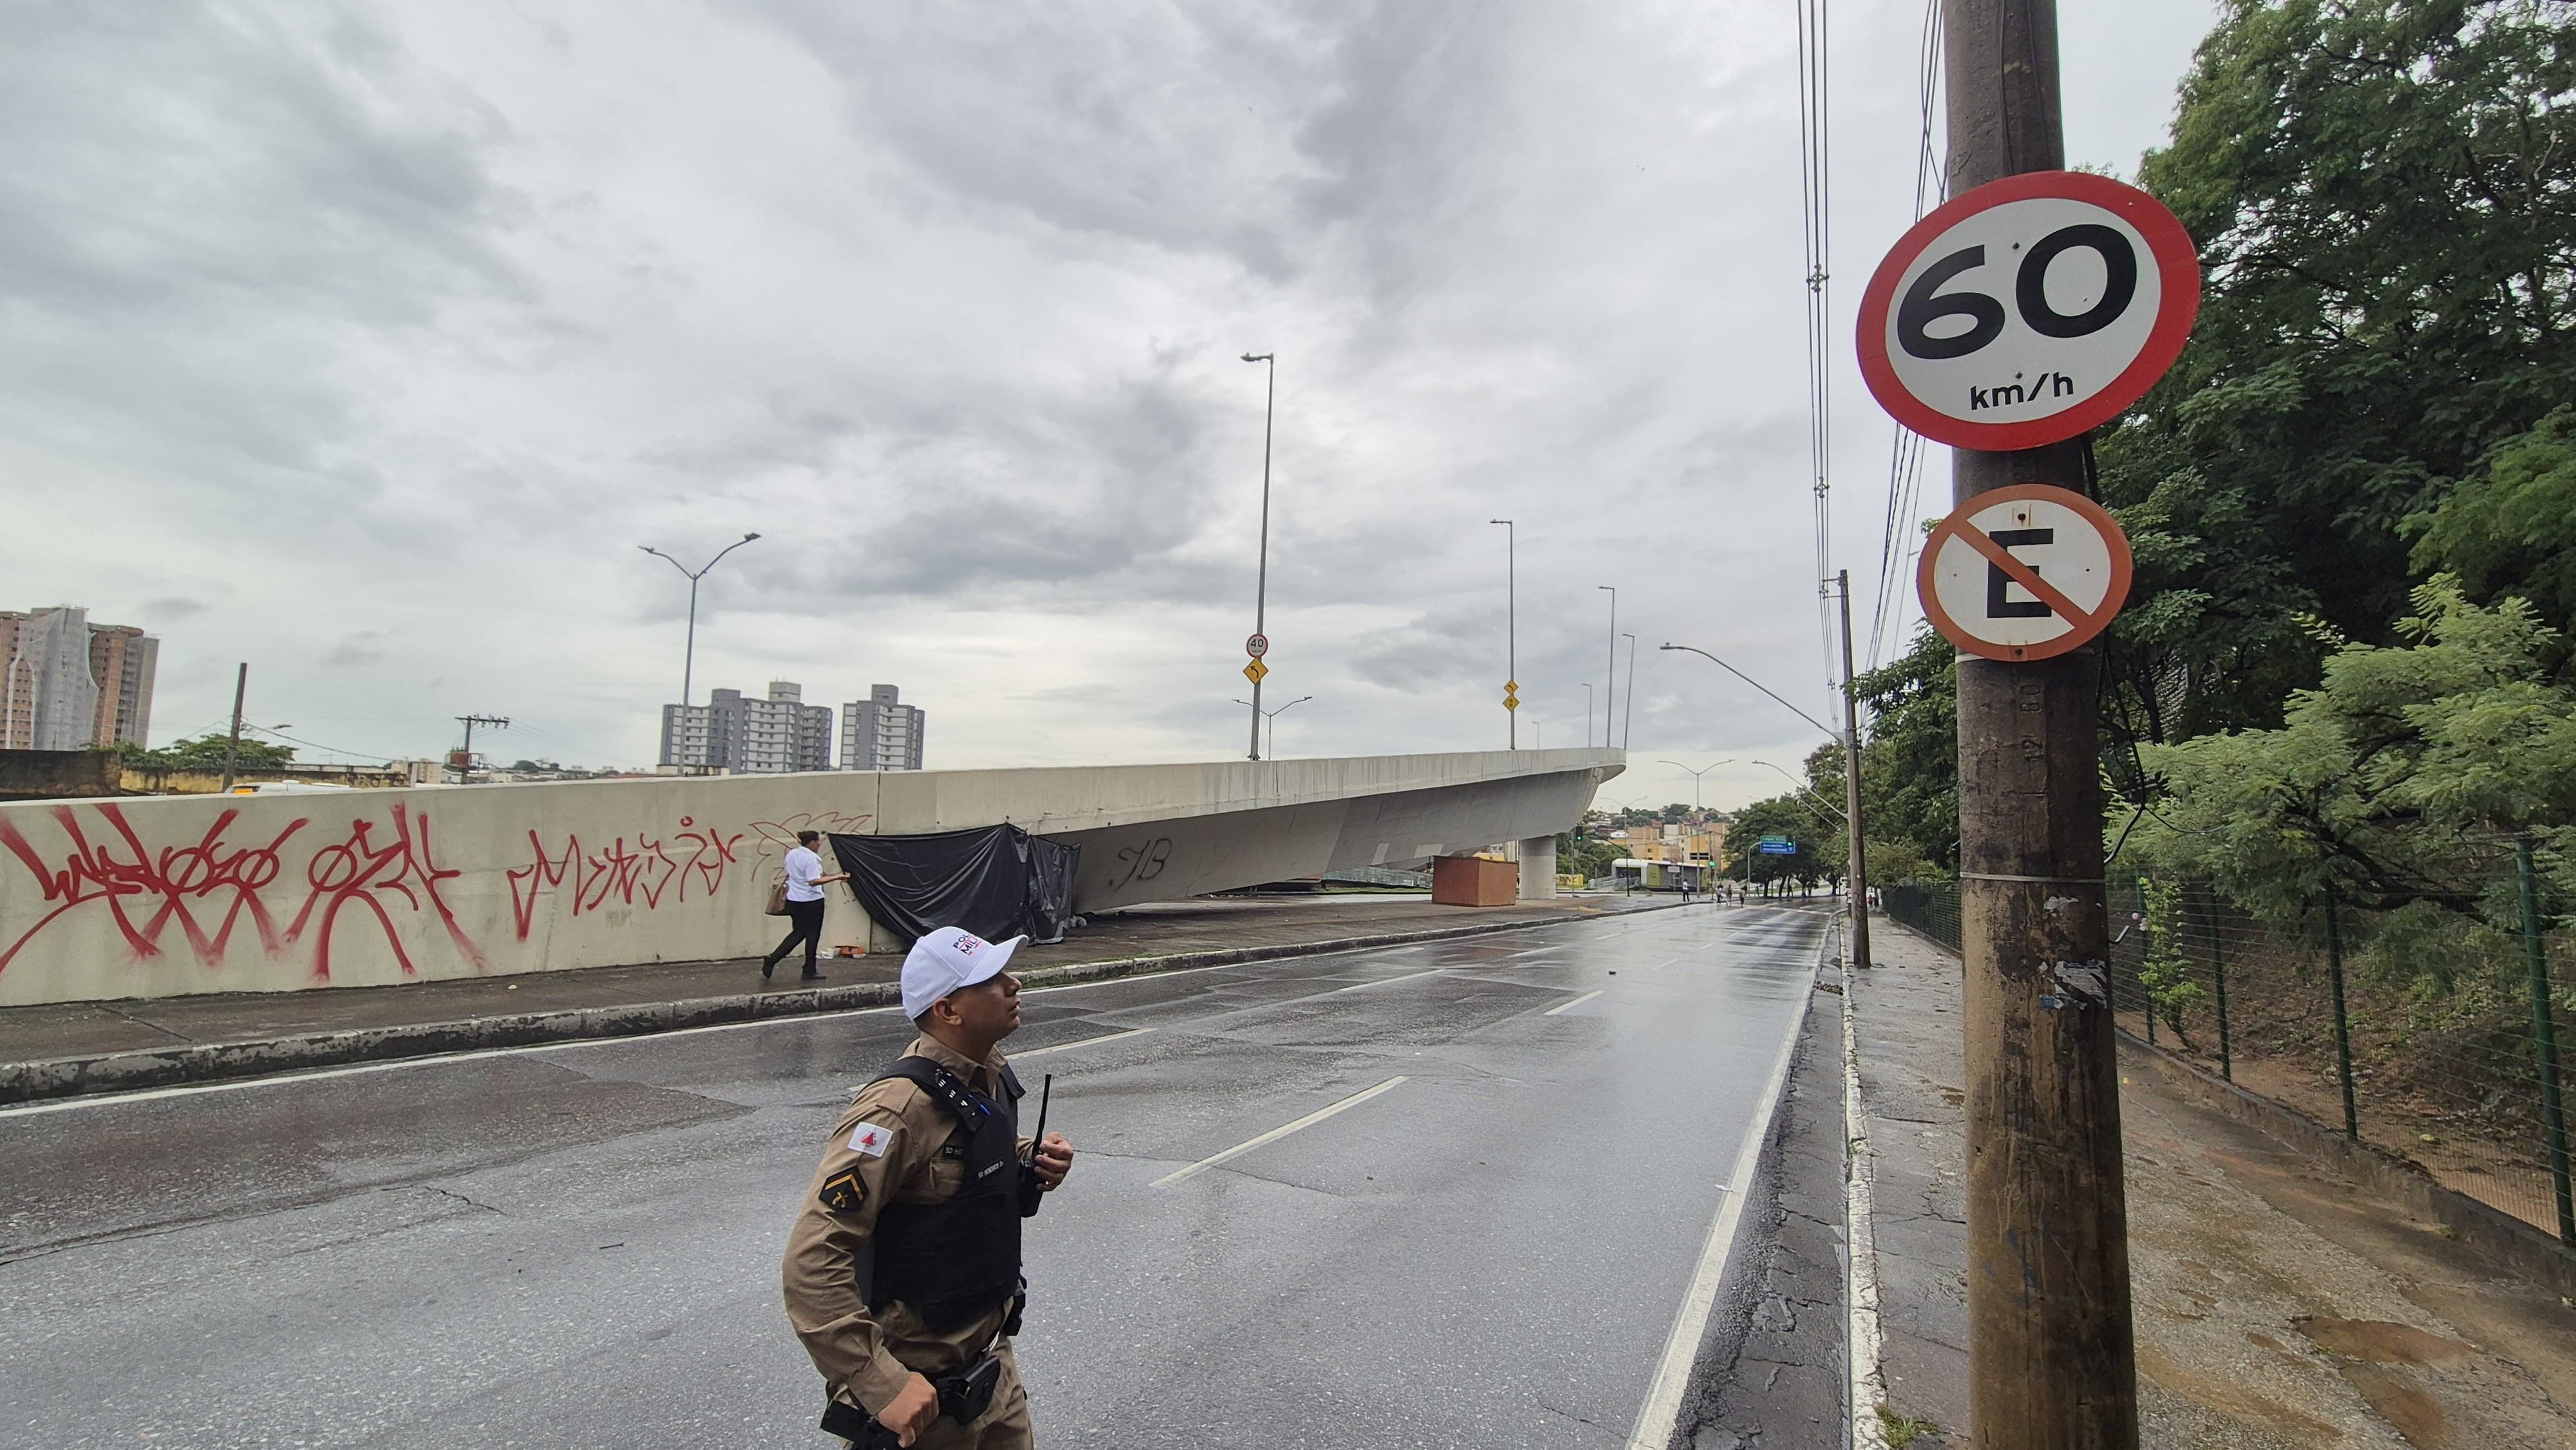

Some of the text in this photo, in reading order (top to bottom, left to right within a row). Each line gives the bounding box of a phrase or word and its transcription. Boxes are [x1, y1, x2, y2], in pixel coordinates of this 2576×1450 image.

[1897, 223, 2138, 360] 60
[1971, 372, 2074, 411] km/h
[1987, 528, 2054, 619] E
[1250, 639, 1264, 648] 40
